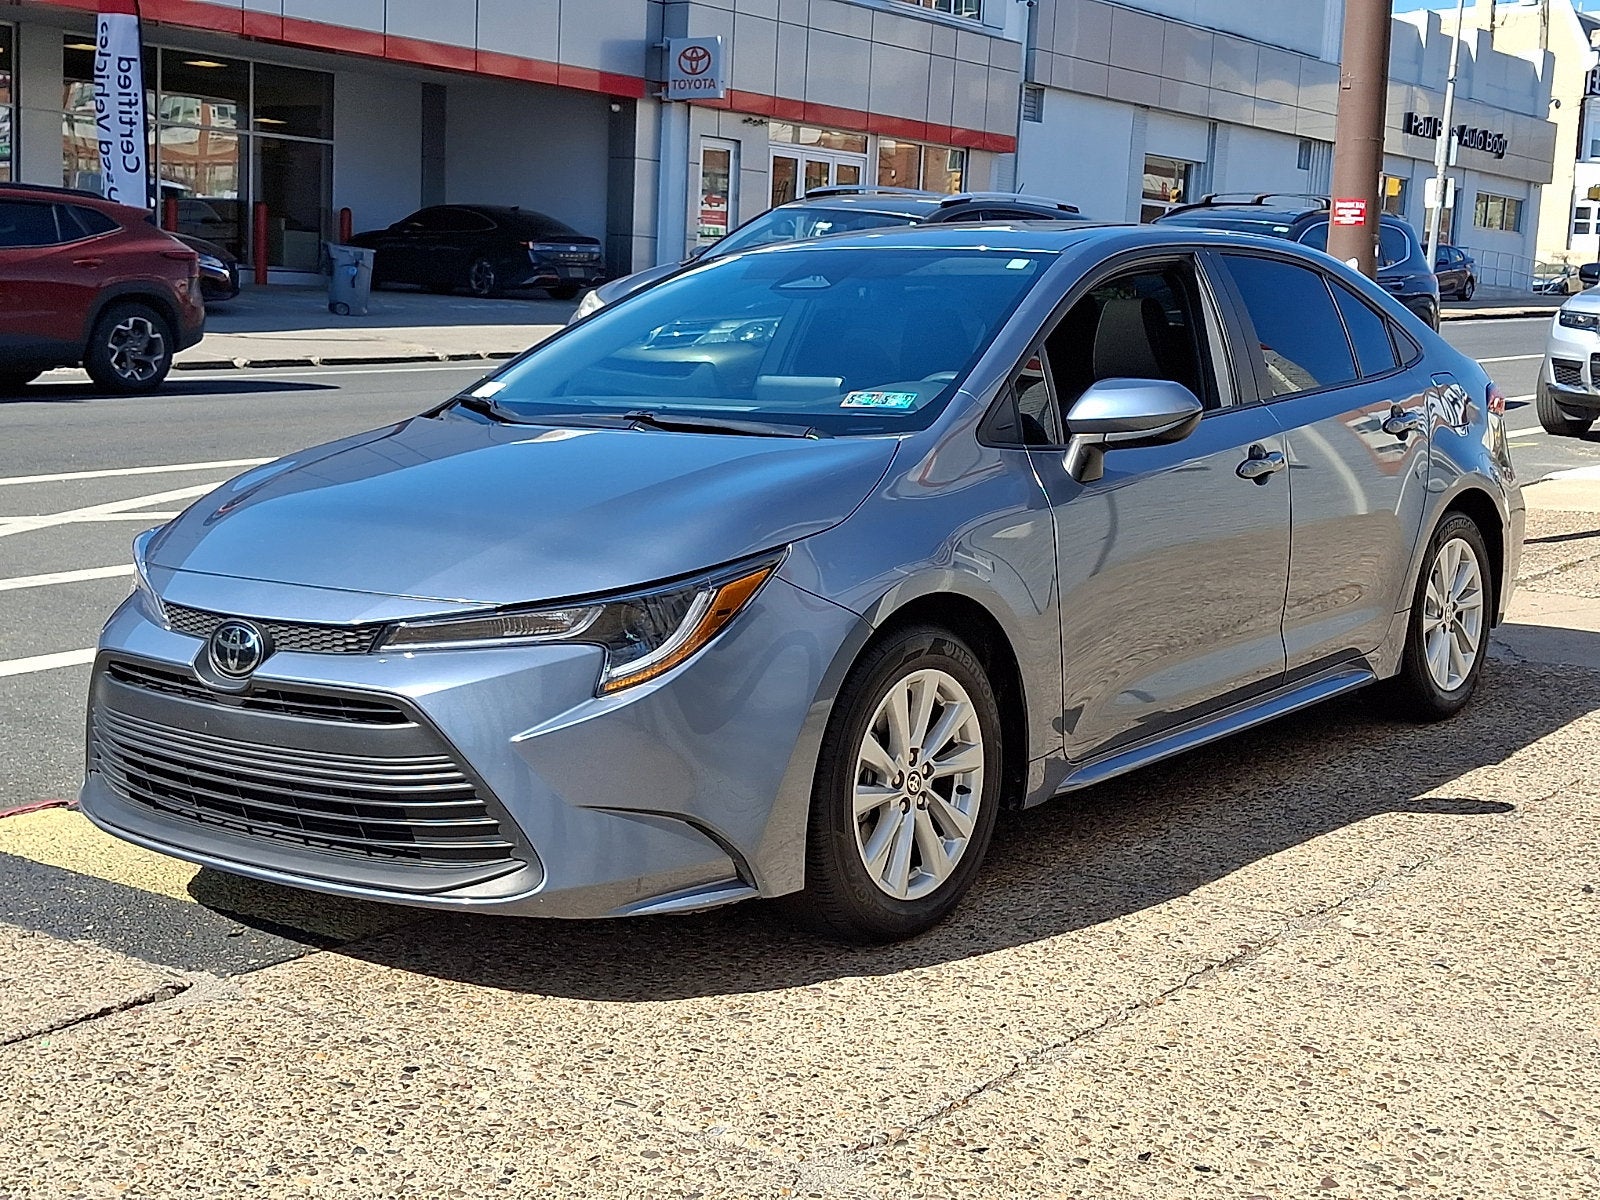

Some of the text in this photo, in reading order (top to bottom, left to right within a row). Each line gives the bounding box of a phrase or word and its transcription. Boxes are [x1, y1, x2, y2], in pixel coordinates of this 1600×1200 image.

[671, 78, 716, 90] TOYOTA
[1409, 112, 1434, 138] Paul
[1462, 126, 1485, 151] Auto
[1486, 130, 1509, 160] Body
